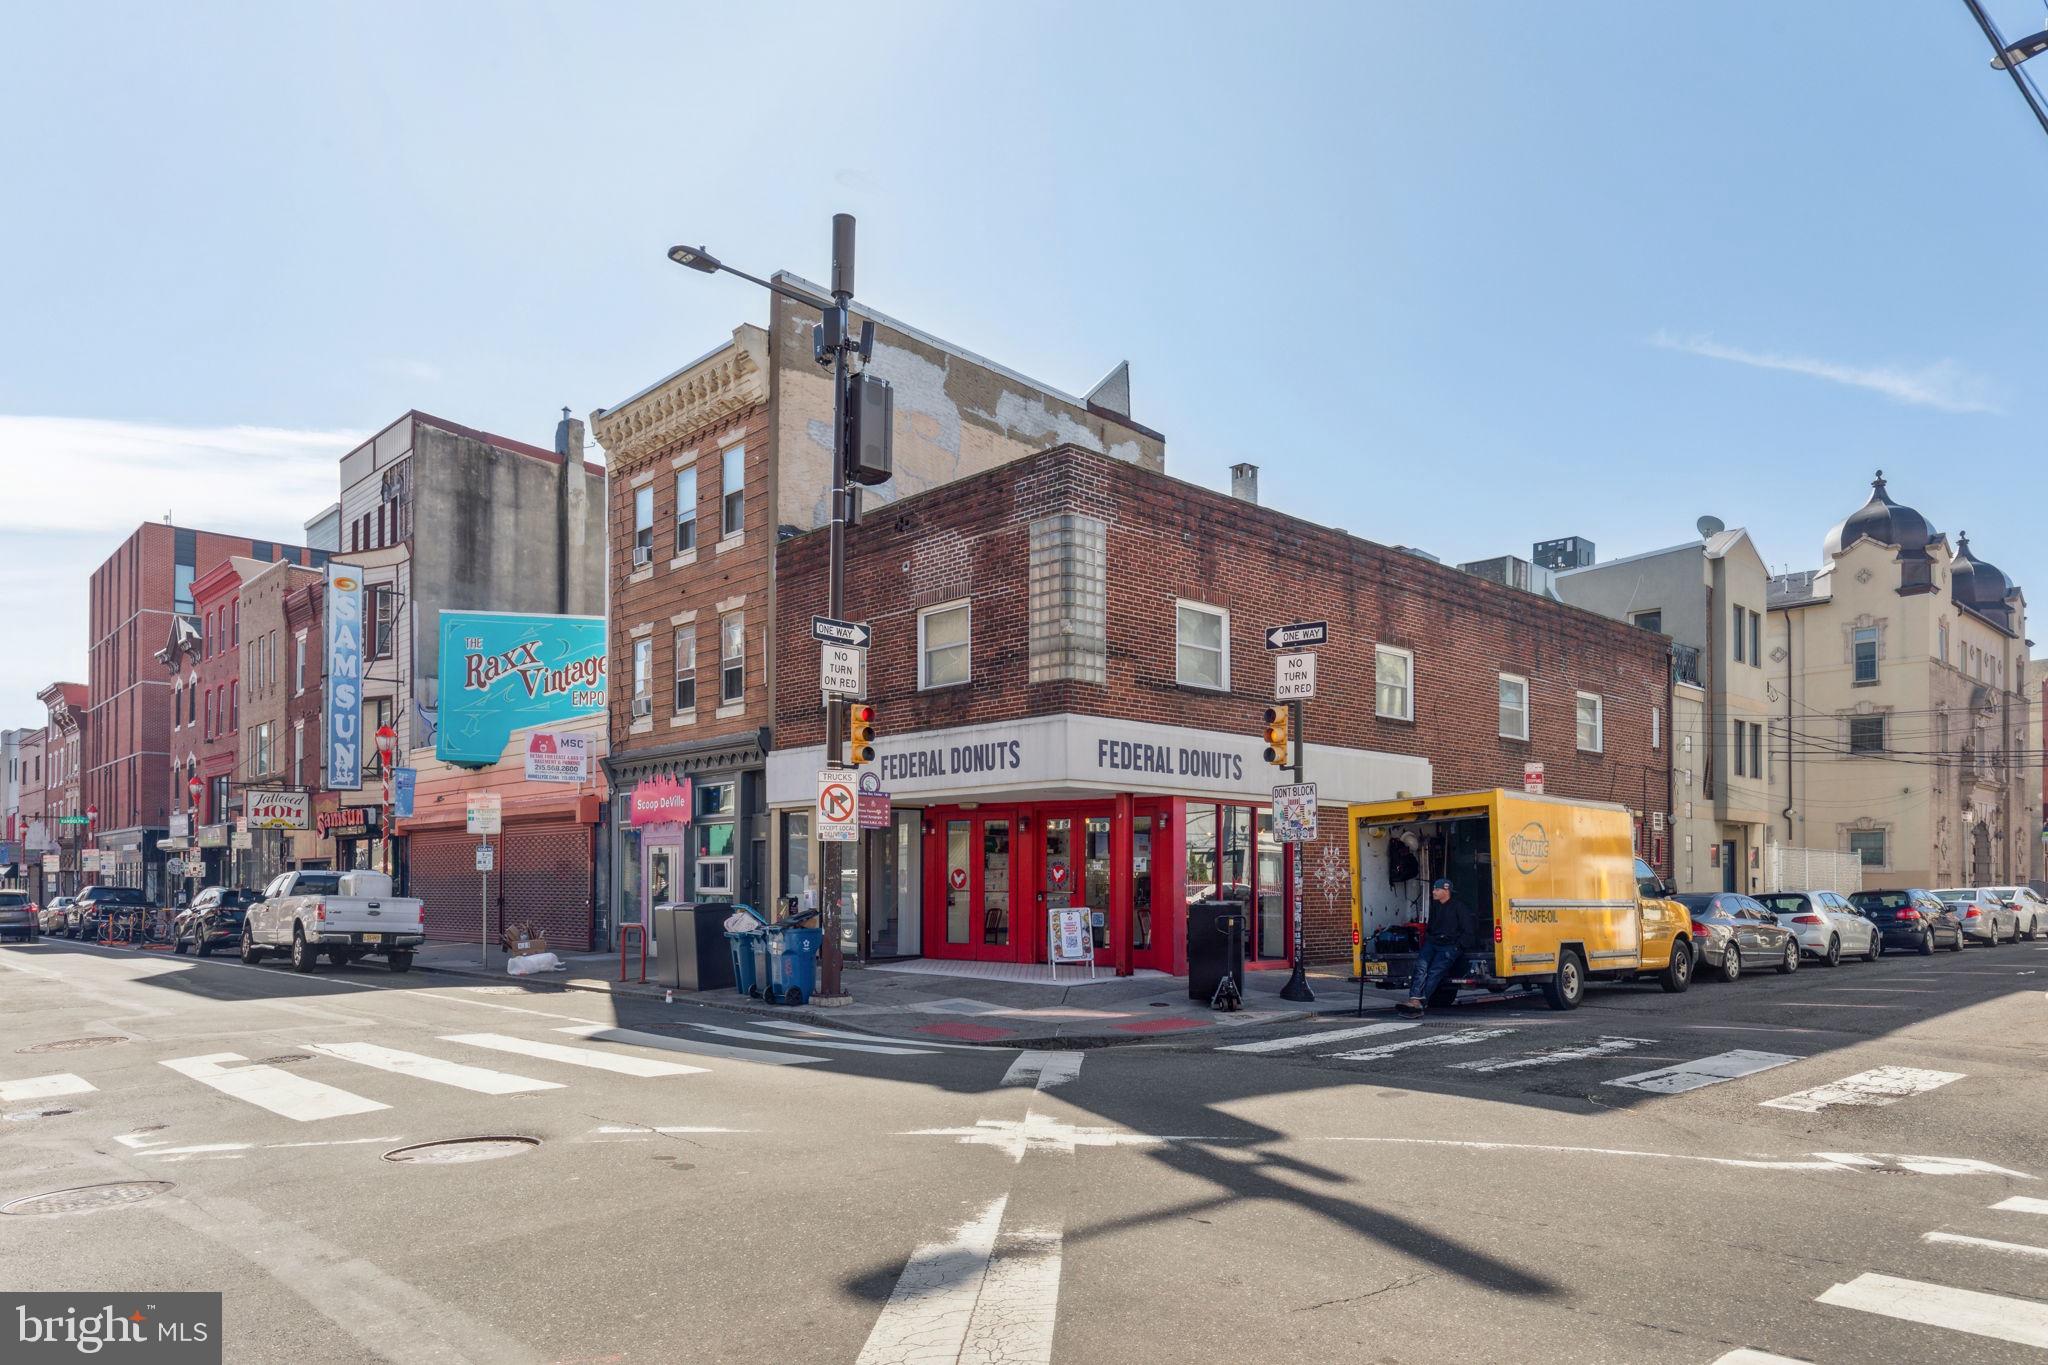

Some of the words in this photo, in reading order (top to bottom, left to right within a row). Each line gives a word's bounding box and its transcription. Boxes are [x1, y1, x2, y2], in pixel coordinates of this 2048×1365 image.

[819, 624, 834, 635] ONE
[836, 629, 853, 638] WAY
[1283, 631, 1300, 641] ONE
[1303, 629, 1320, 639] WAY
[465, 638, 483, 650] THE
[834, 651, 848, 661] NO
[464, 640, 543, 690] Raxx
[830, 663, 853, 675] TURN
[1289, 658, 1303, 668] NO
[824, 676, 836, 685] ON
[840, 678, 857, 688] RED
[1284, 671, 1307, 681] TURN
[334, 594, 358, 776] SAMSUN
[1279, 685, 1291, 694] ON
[1295, 683, 1311, 693] RED
[560, 738, 584, 749] MSC
[880, 749, 946, 780] FEDERAL
[950, 740, 1020, 774] DONUTS
[1098, 739, 1174, 774] FEDERAL
[1179, 748, 1242, 780] DONUTS
[823, 773, 853, 781] TRUCKS
[1293, 785, 1314, 796] BLOCK
[637, 799, 658, 811] Scoop
[660, 795, 685, 808] DeVille
[316, 808, 364, 840] Samsun
[1509, 909, 1559, 923] 1-877-SAFE-OIL
